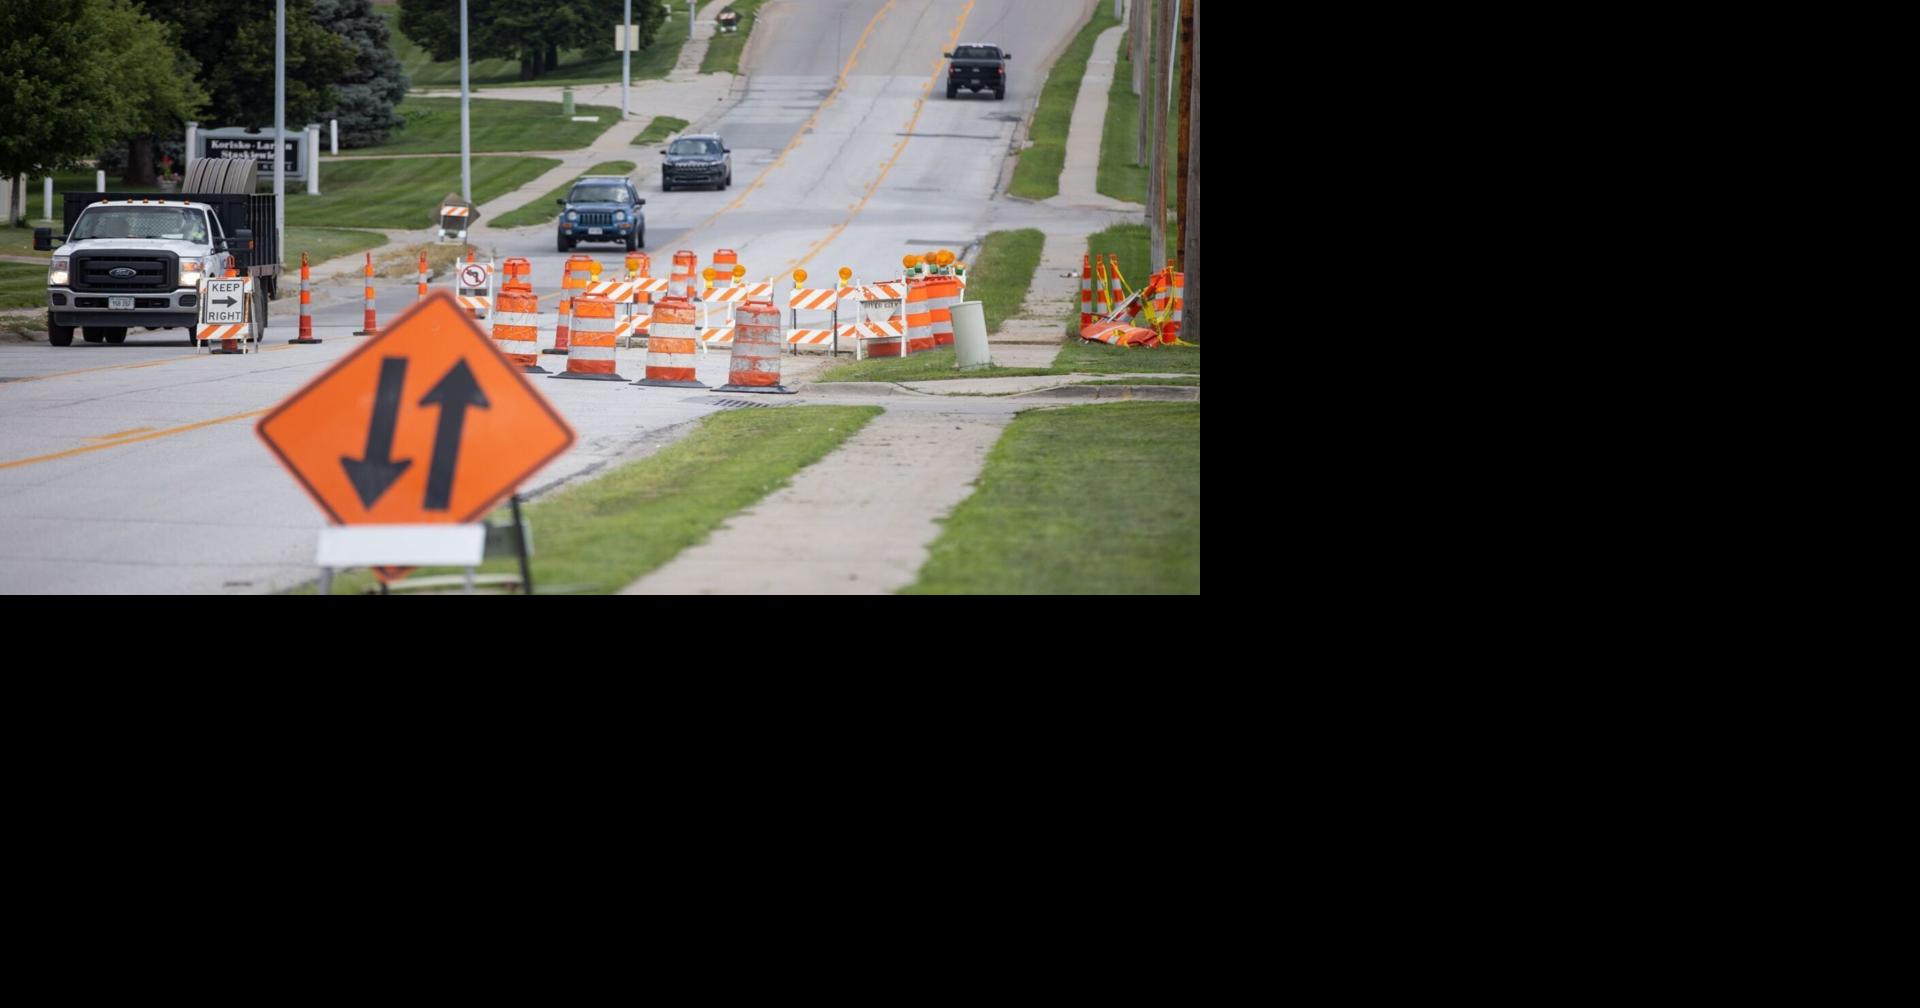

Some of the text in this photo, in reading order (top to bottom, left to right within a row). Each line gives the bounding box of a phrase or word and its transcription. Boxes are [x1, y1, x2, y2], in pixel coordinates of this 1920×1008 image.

[211, 140, 251, 149] Korisko
[257, 141, 292, 150] Larn
[212, 283, 240, 292] KEEP
[208, 311, 242, 321] RIGHT
